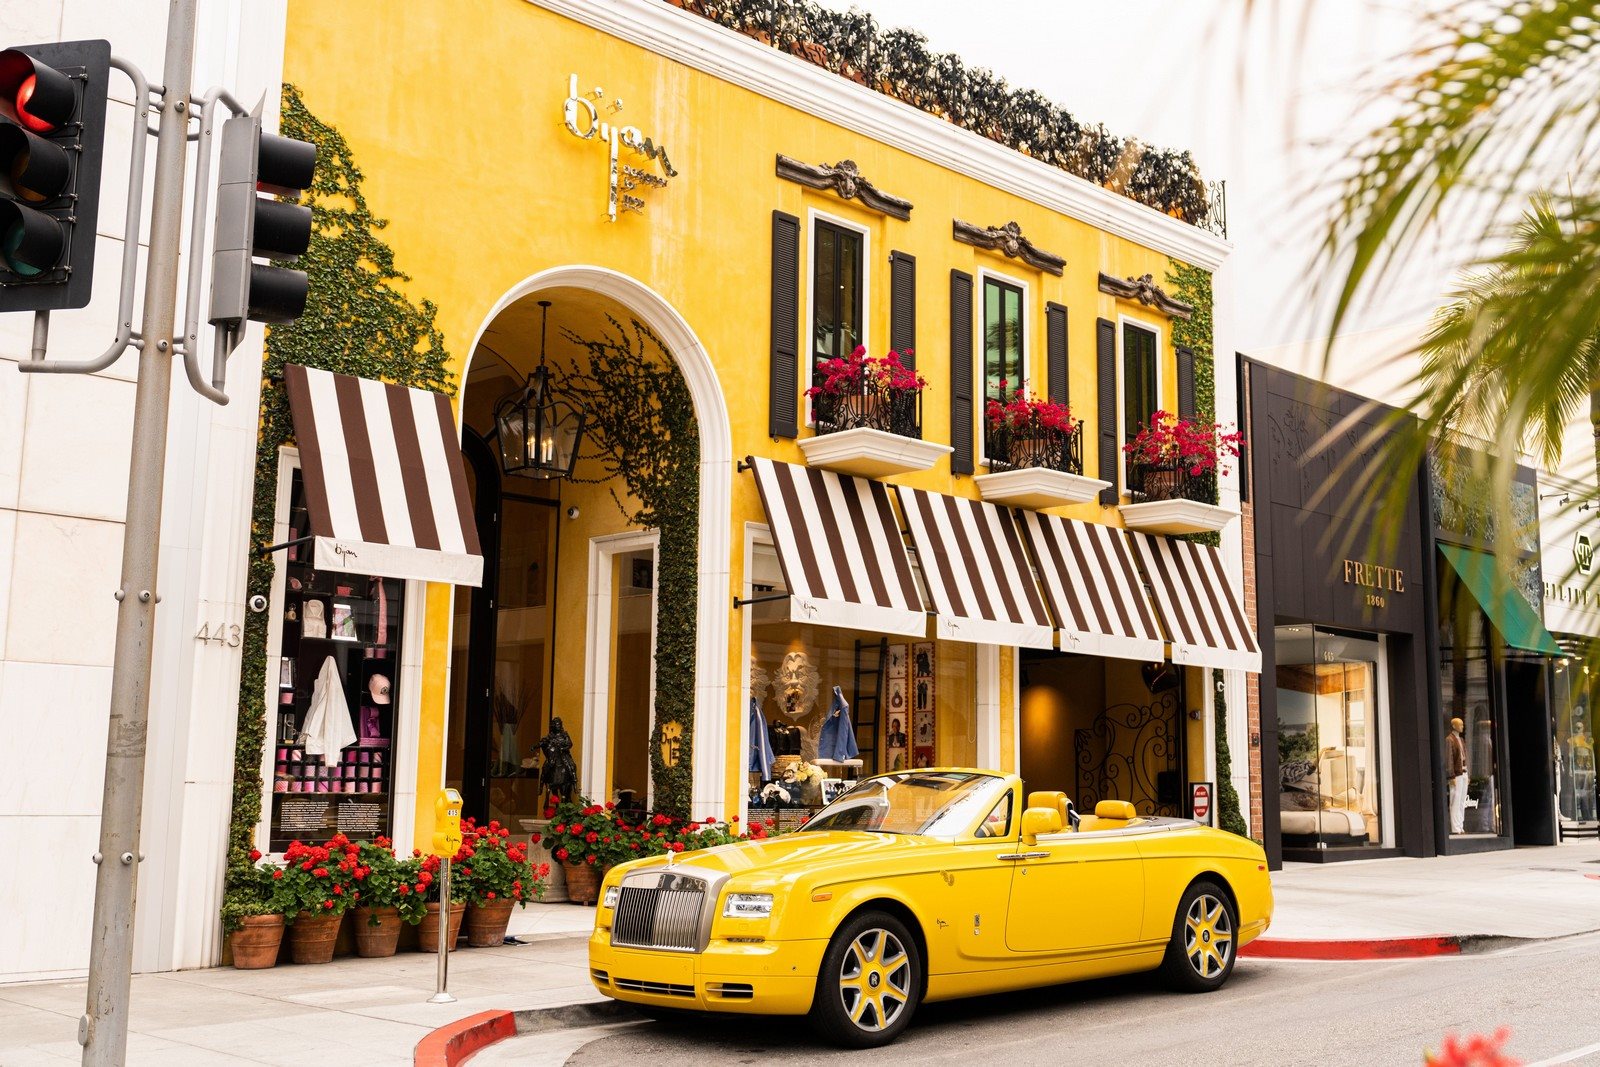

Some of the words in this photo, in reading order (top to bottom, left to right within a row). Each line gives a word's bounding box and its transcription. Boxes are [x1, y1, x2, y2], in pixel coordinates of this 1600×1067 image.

[1344, 559, 1404, 592] FRETTE
[1366, 594, 1385, 607] 1860
[193, 621, 241, 647] 443
